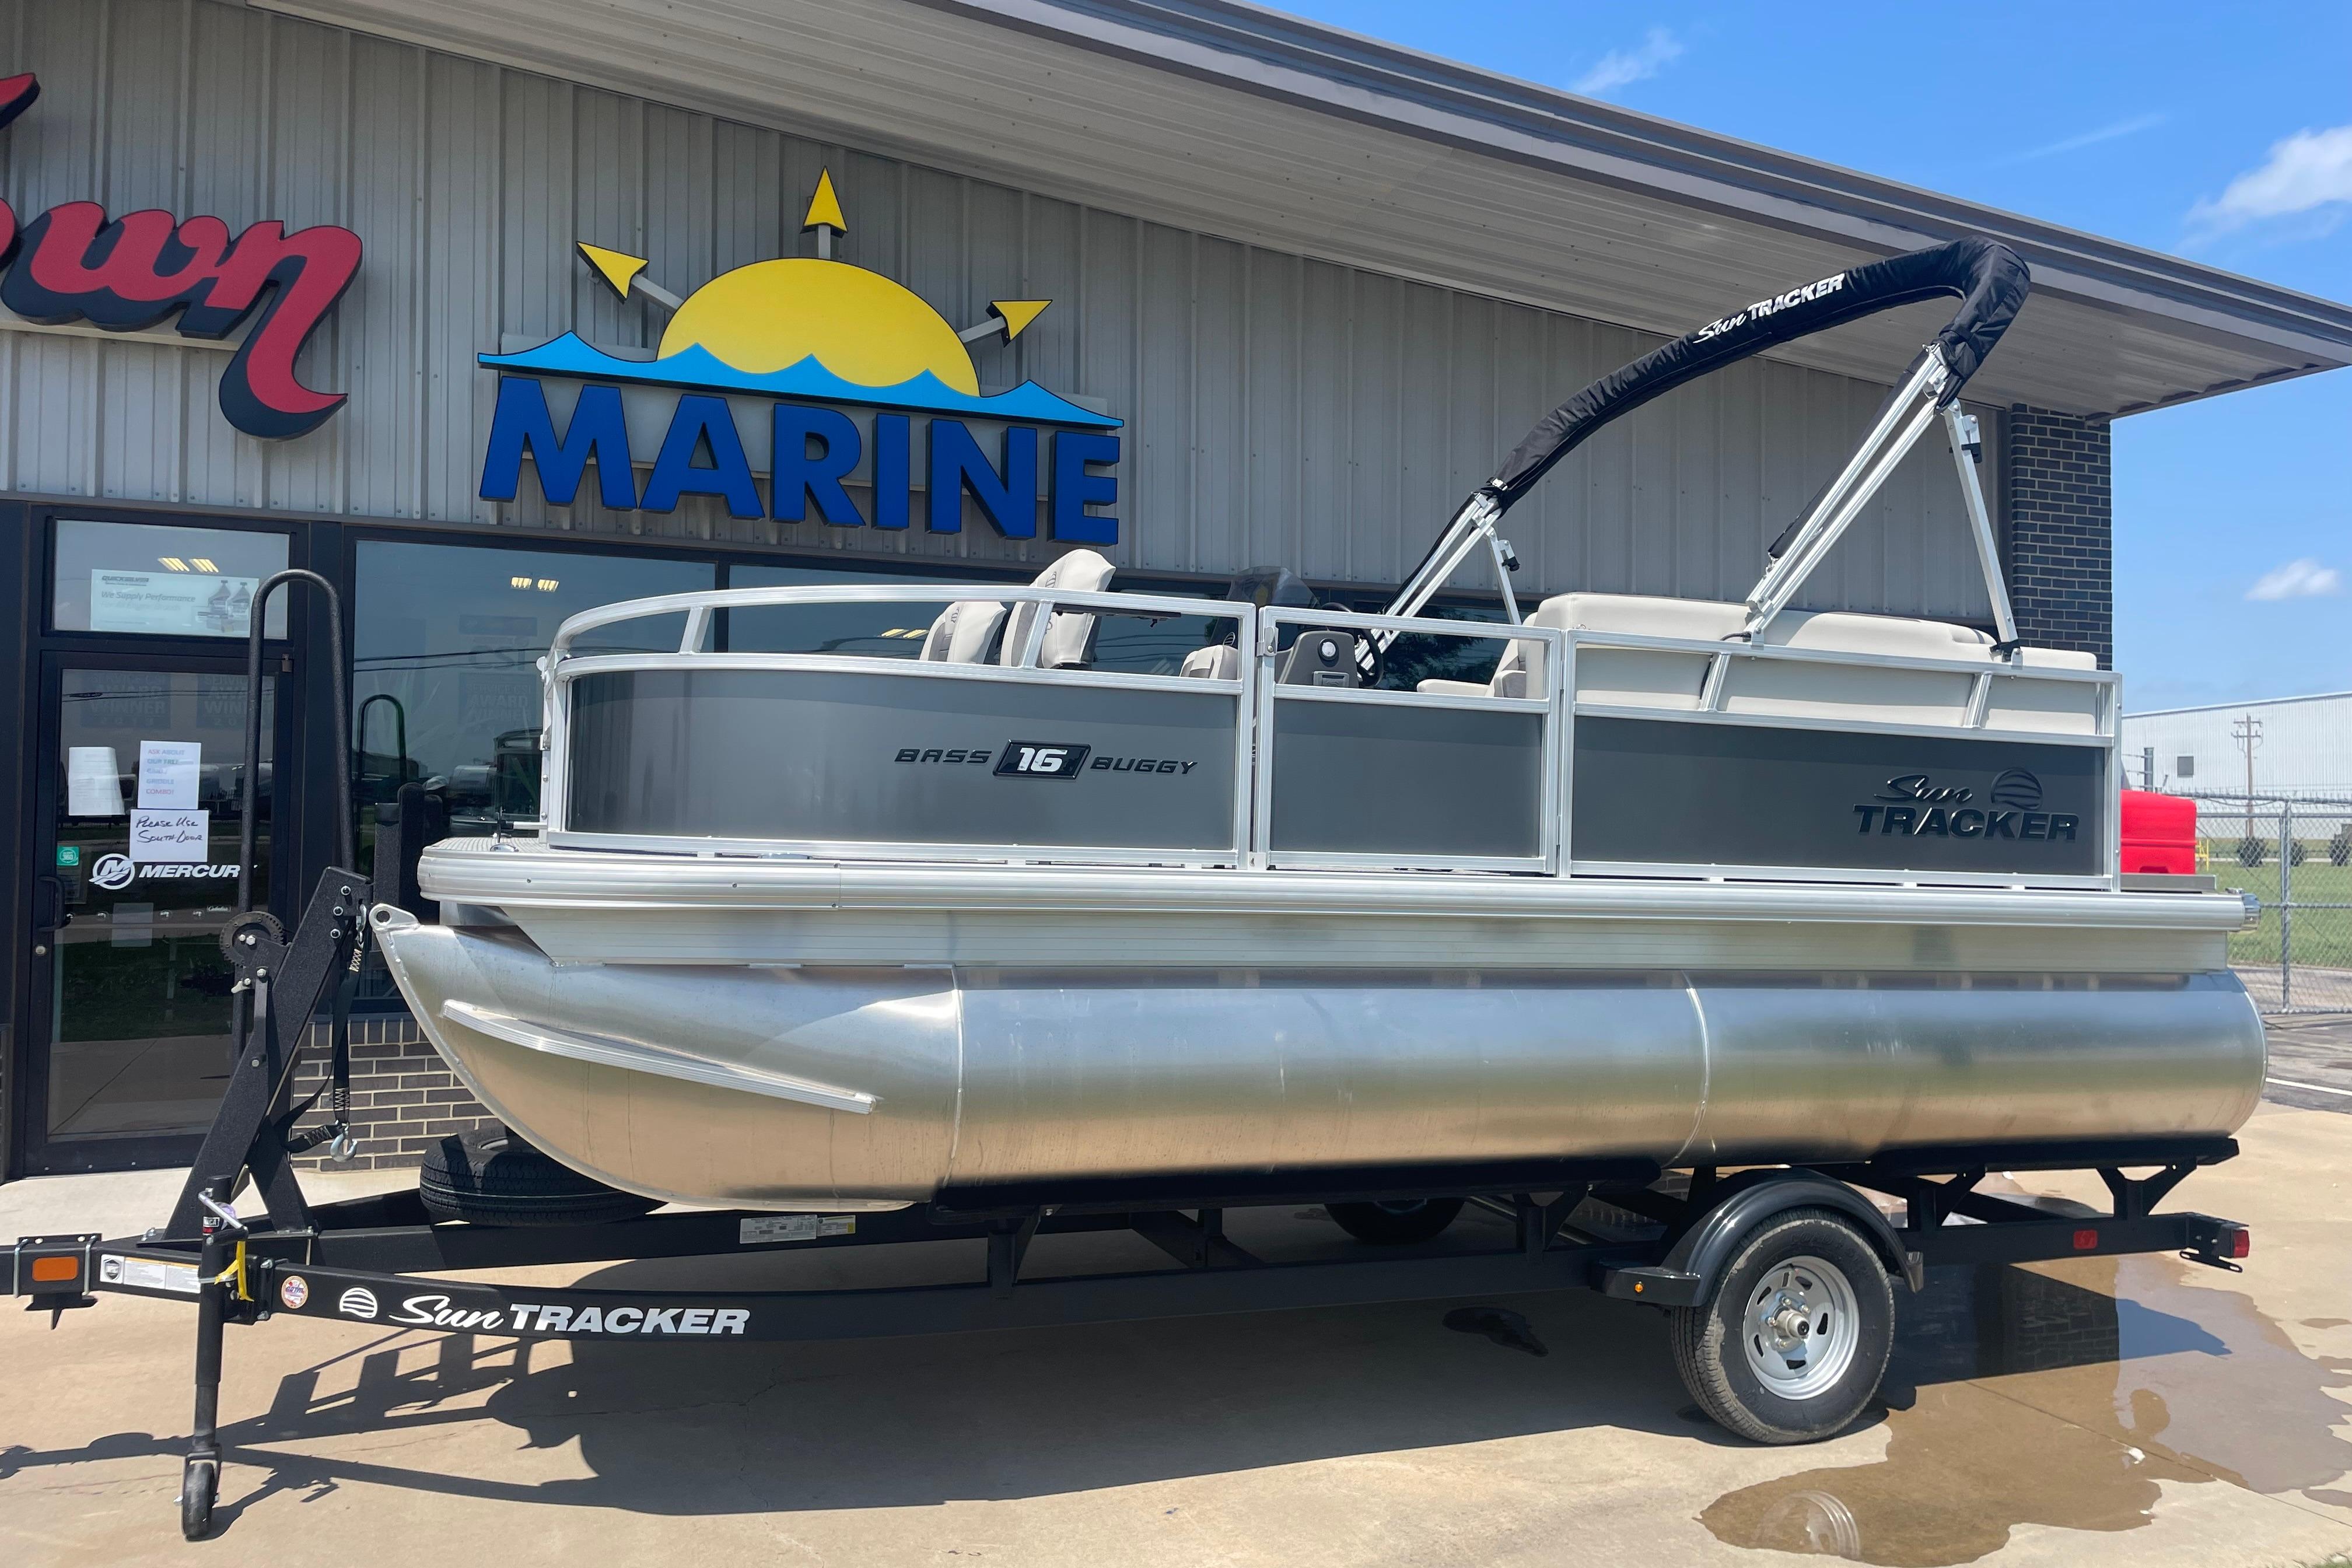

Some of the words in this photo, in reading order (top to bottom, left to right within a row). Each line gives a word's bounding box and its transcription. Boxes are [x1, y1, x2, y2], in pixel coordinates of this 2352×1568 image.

[1692, 313, 1746, 344] Sun
[1746, 272, 1846, 321] TRACKER
[478, 376, 1121, 545] MARINE
[102, 590, 114, 598] We
[116, 592, 145, 601] Supply
[145, 593, 196, 603] Performance
[894, 748, 992, 764] BASS
[1017, 747, 1067, 772] 16
[1090, 757, 1198, 775] BUGGY
[1874, 774, 1973, 804] Sun
[1852, 804, 2079, 843] TRACKER
[138, 864, 240, 878] MERCUR
[389, 1294, 504, 1329] Sun
[509, 1303, 751, 1335] TRACKER
